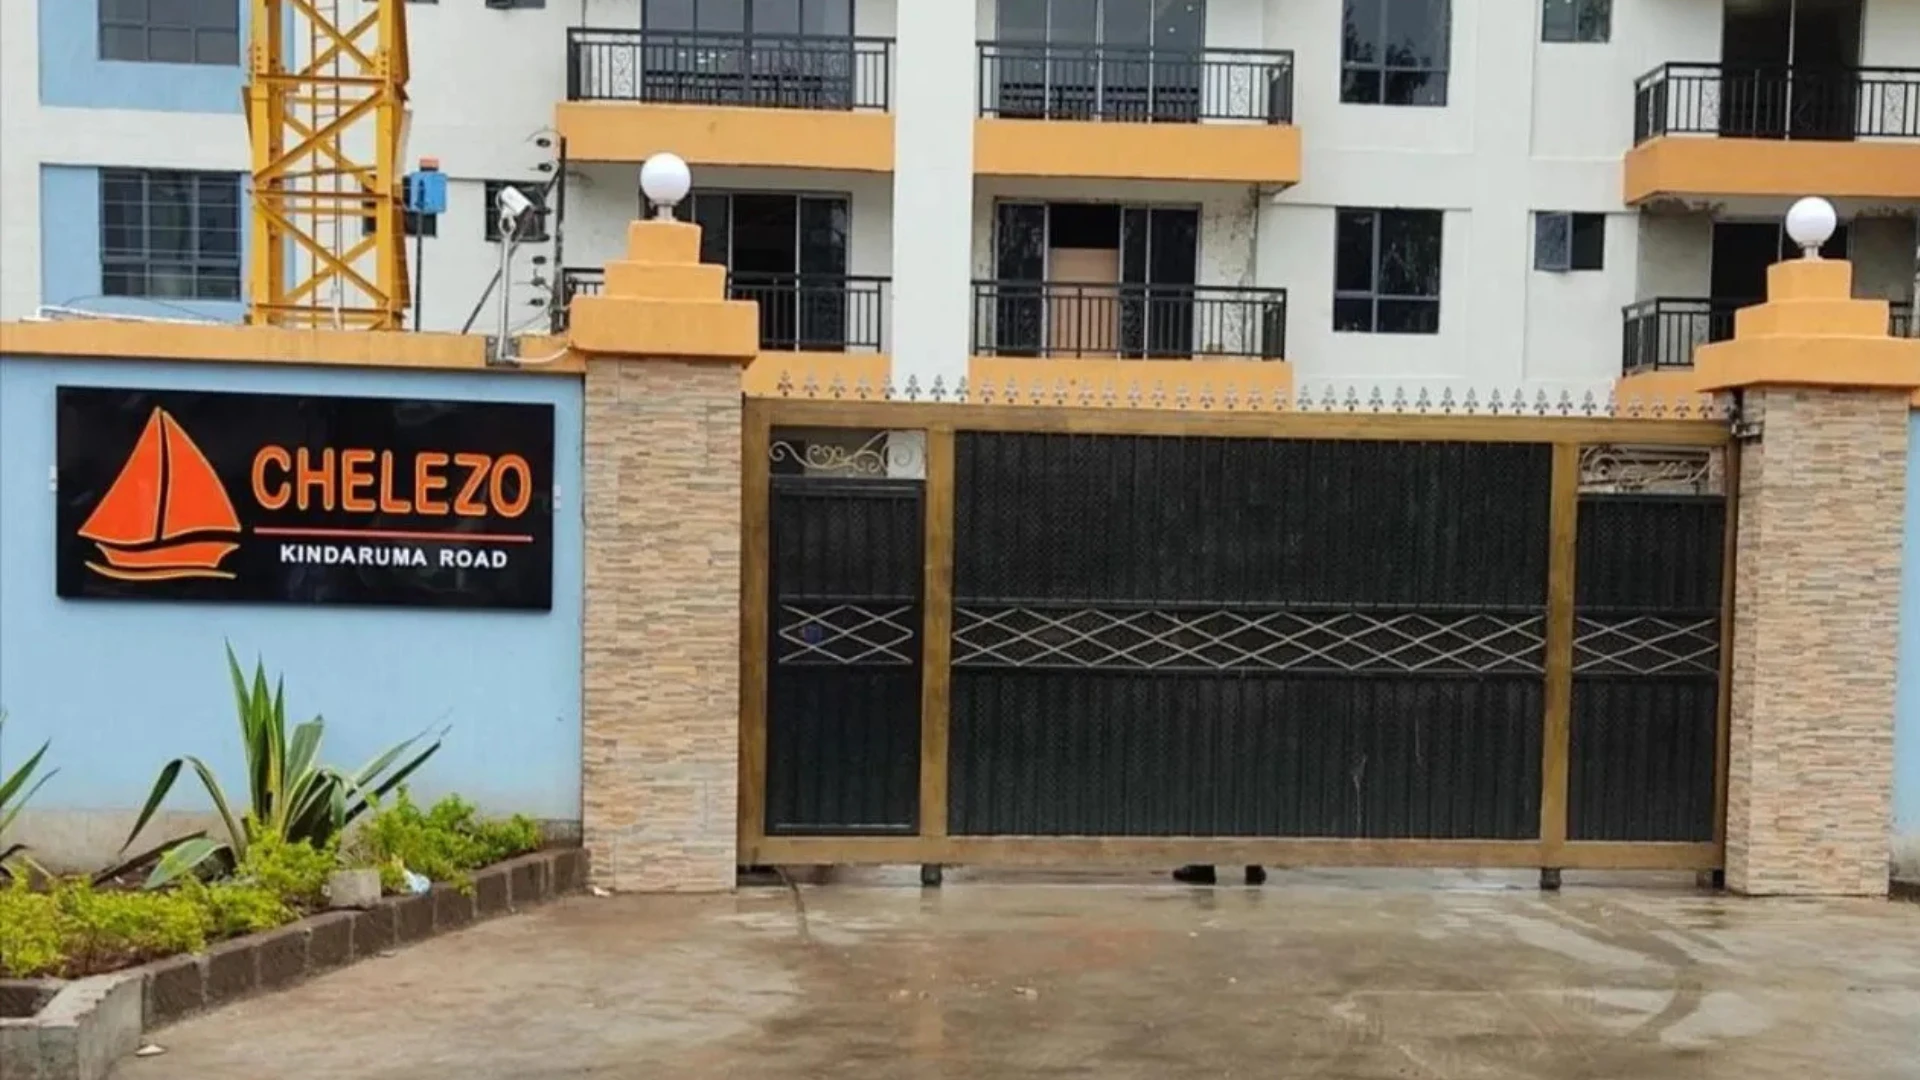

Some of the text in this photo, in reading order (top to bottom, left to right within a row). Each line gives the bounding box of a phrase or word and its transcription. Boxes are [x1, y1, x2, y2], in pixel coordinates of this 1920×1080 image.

[251, 445, 532, 518] CHELEZO
[280, 544, 508, 569] KINDARUMA ROAD
